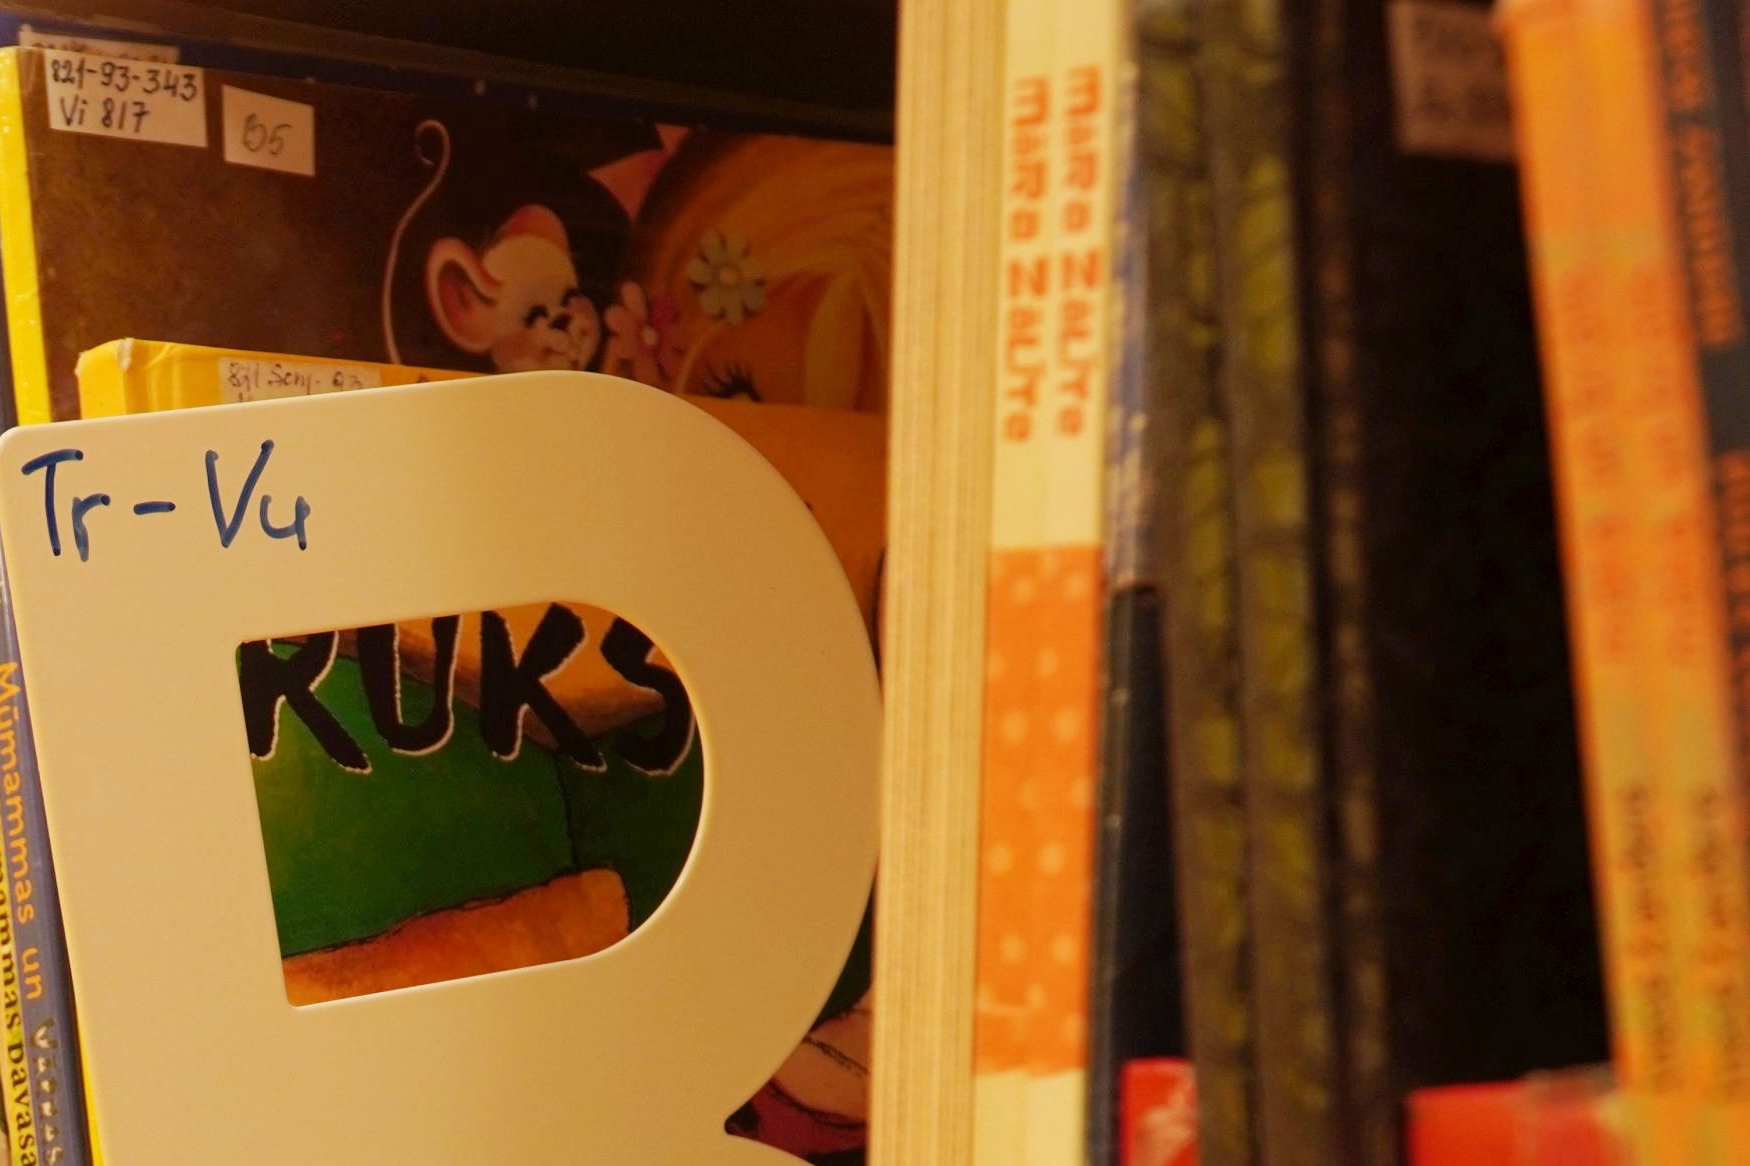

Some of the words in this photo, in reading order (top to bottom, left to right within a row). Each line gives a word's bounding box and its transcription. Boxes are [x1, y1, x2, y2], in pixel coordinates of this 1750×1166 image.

[50, 57, 198, 100] 821-93-343
[58, 95, 87, 126] Vi
[101, 101, 150, 133] 817
[20, 448, 111, 562] Tr
[205, 439, 311, 551] Vu
[21, 945, 45, 1000] un
